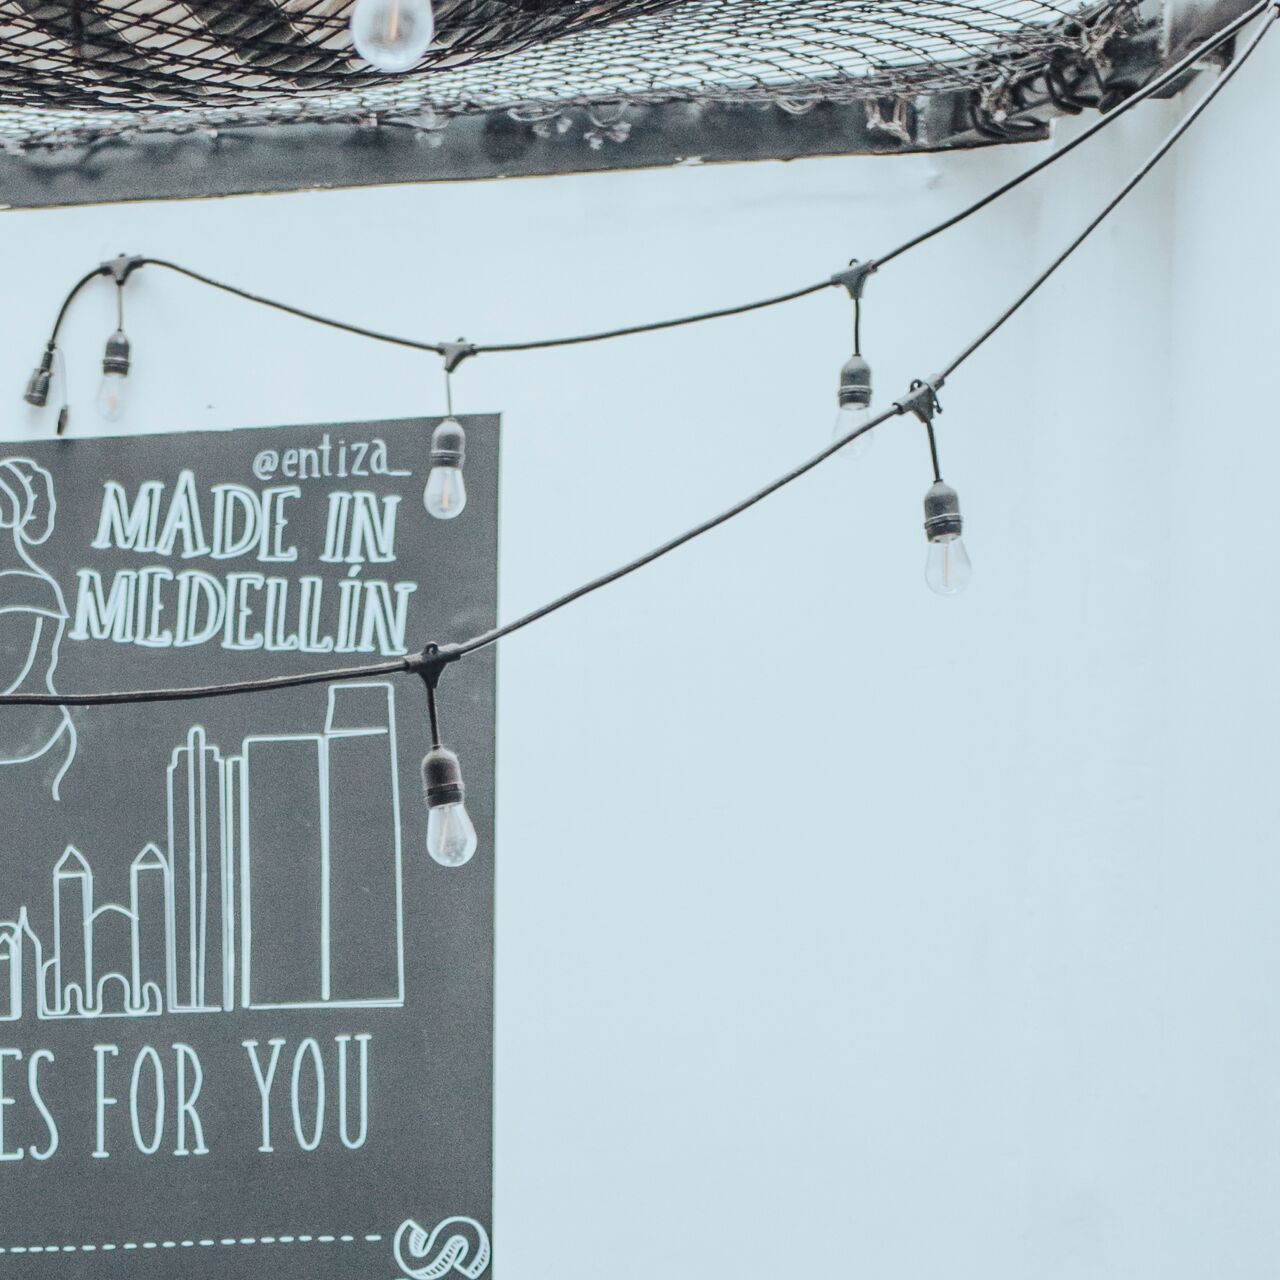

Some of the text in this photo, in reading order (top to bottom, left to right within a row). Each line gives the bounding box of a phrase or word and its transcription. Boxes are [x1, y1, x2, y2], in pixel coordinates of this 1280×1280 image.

[91, 470, 402, 563] MADE IN
[68, 564, 418, 656] MEDELLÍN
[92, 1043, 209, 1158] FOR
[242, 1033, 372, 1152] YOU
